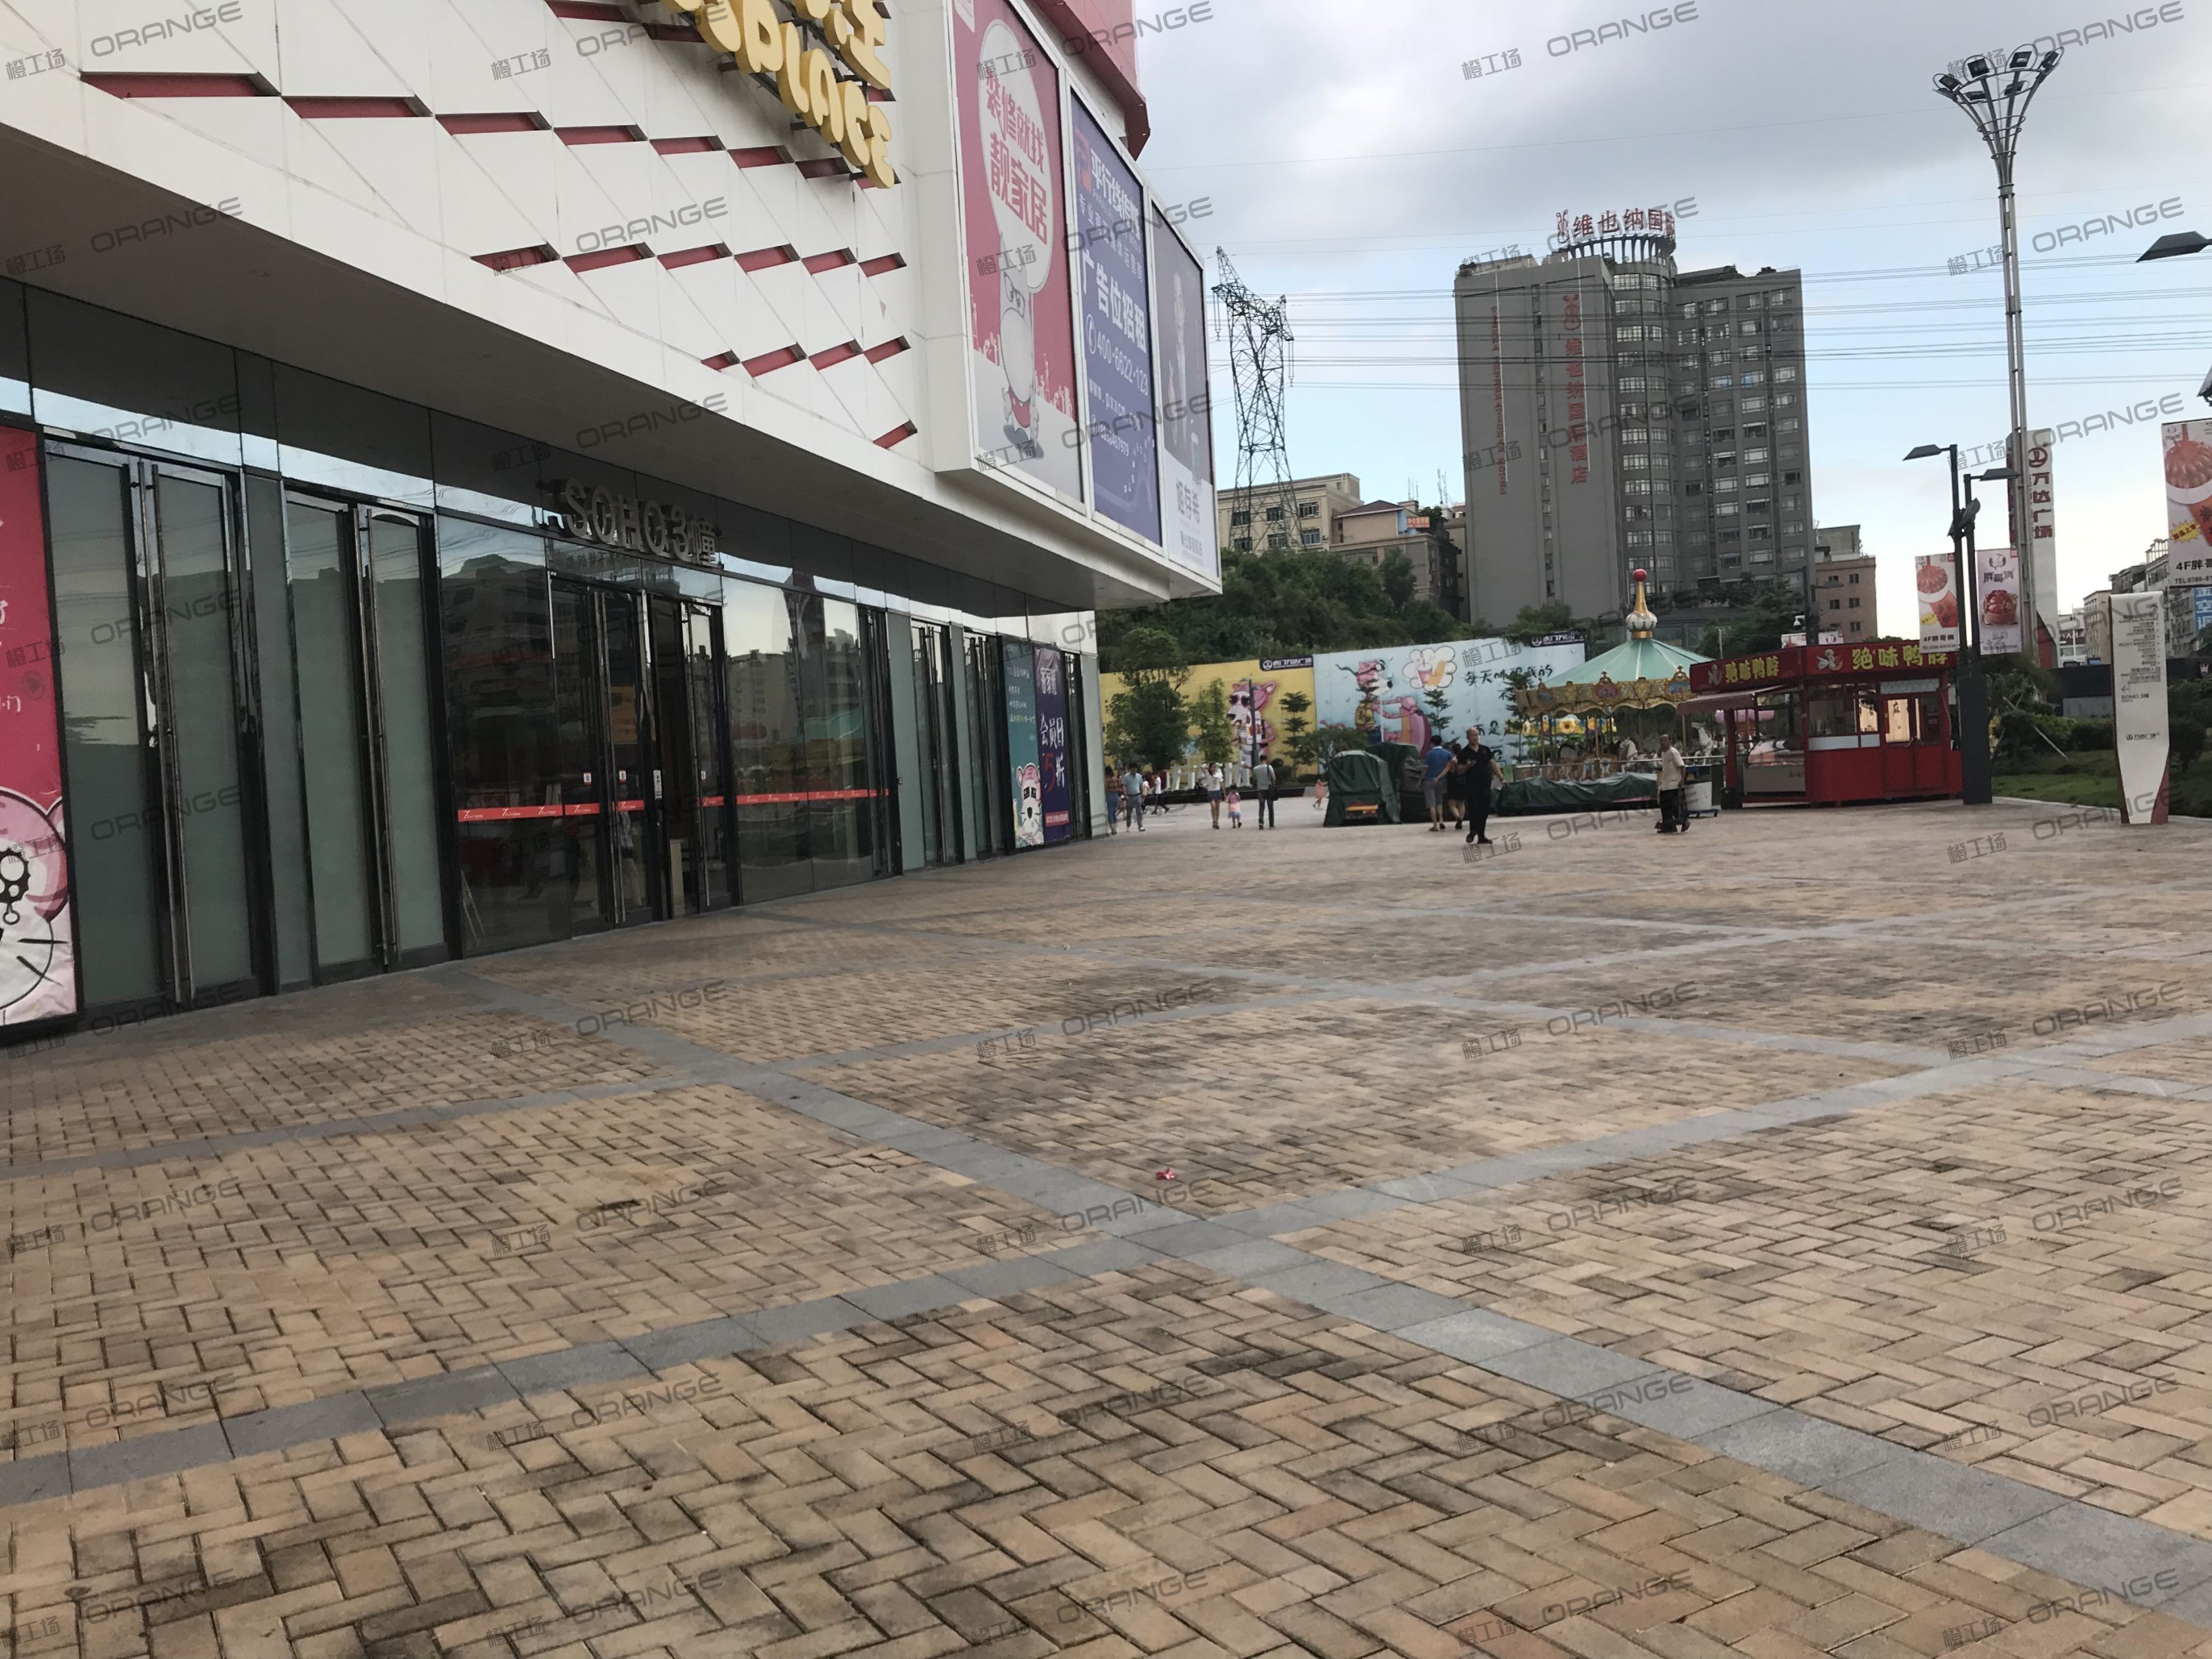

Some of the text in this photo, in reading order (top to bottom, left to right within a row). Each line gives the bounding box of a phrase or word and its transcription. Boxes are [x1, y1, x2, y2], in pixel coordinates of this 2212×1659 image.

[986, 70, 1044, 174] 装修就找
[990, 131, 1047, 245] 靓家居
[1081, 248, 1146, 353] 广告位招租
[2032, 472, 2053, 539] 万达广场
[1725, 655, 1780, 683] 绝味鸭脖
